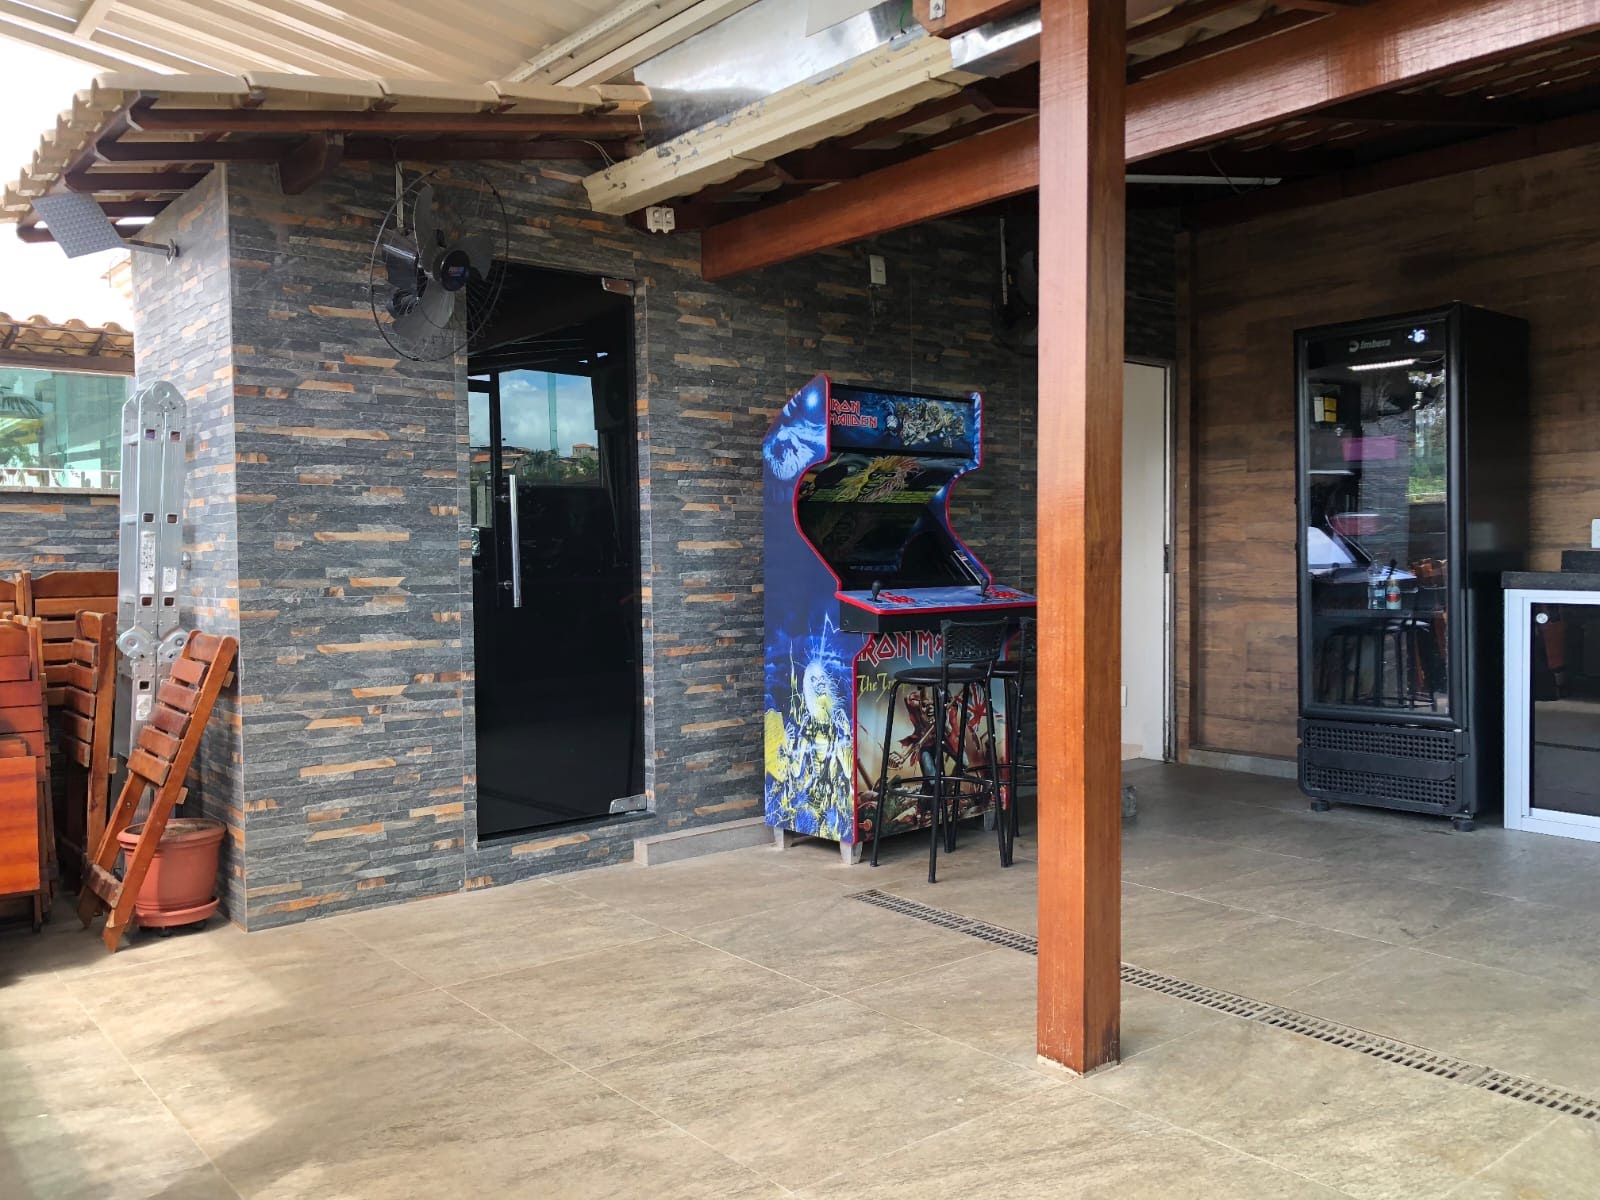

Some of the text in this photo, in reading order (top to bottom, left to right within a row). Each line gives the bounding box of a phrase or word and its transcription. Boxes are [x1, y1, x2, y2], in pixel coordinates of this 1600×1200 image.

[830, 398, 860, 416] RON
[830, 412, 878, 428] MAIDEN
[857, 631, 912, 667] RON
